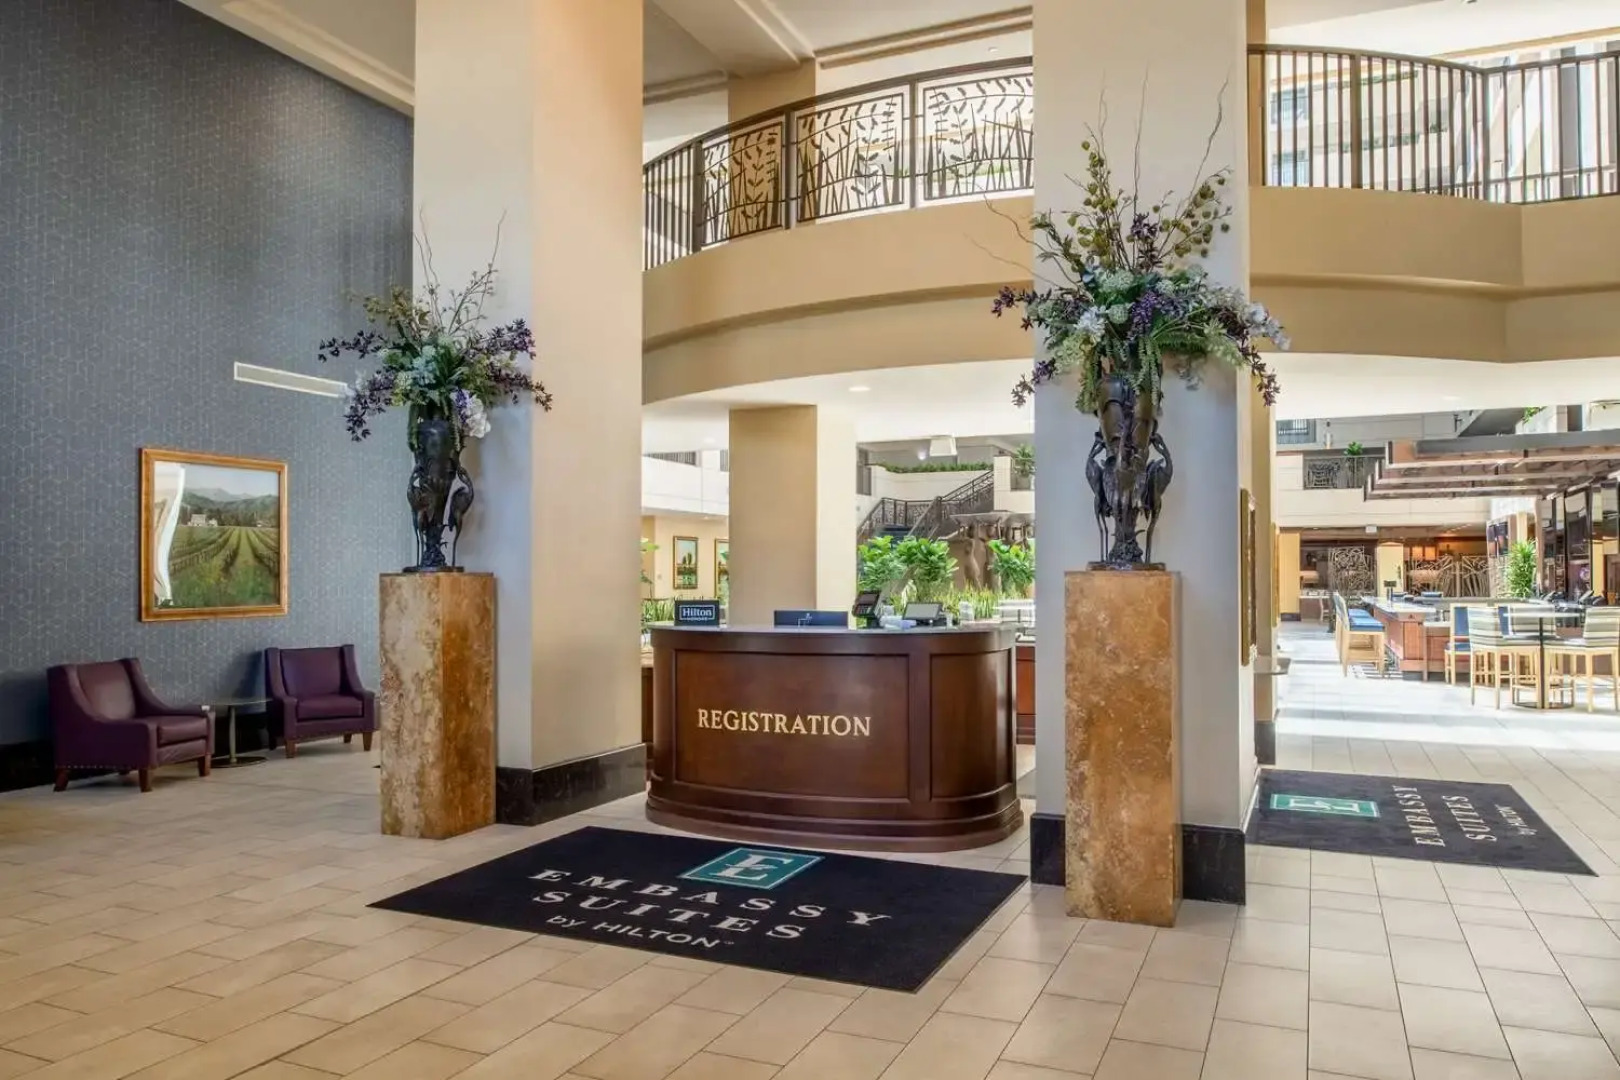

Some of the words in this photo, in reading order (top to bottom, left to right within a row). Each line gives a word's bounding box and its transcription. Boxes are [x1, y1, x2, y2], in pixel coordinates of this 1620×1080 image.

[682, 607, 712, 617] Hilton
[698, 708, 872, 737] REGISTRATION
[1392, 785, 1446, 847] EMBASSY
[1442, 794, 1497, 842] SUITES
[708, 853, 797, 881] E
[526, 868, 892, 926] EMBASSY
[532, 890, 806, 940] SUITES
[545, 914, 586, 931] by
[593, 921, 720, 948] HILTON
